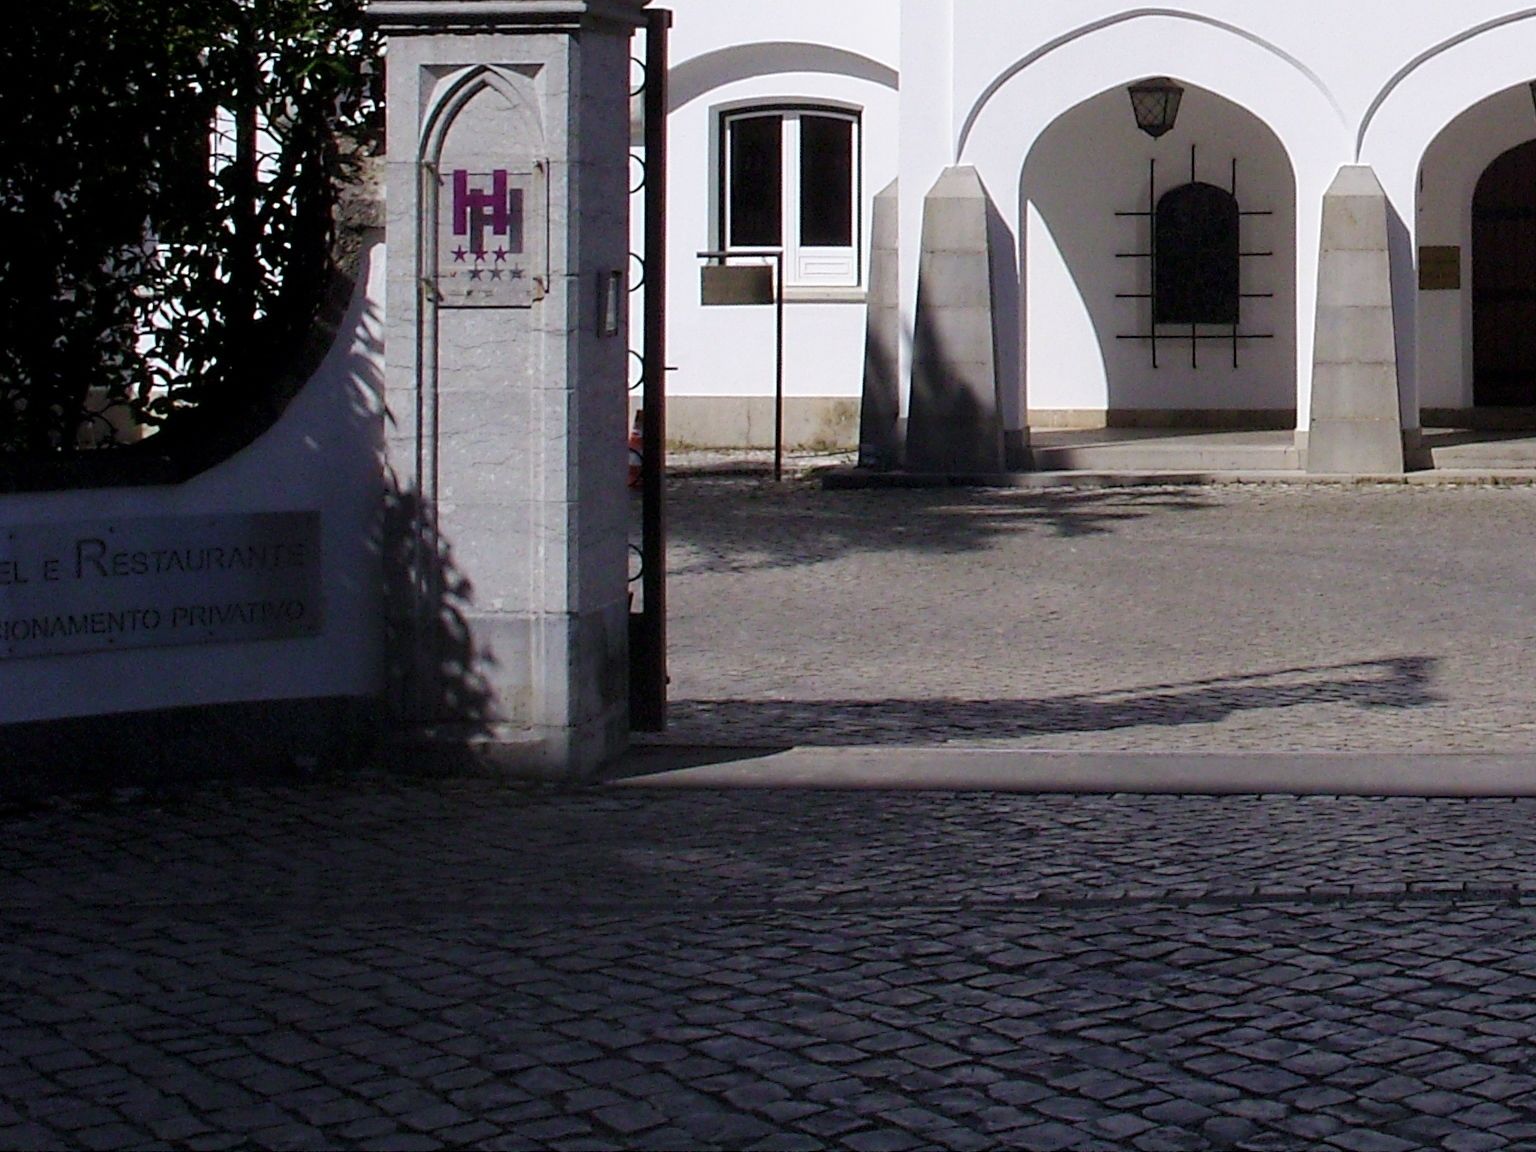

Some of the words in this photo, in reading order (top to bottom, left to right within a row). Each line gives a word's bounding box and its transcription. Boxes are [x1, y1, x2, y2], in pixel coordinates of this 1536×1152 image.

[41, 559, 59, 581] E
[76, 538, 305, 579] RESTAURANTE
[0, 608, 161, 641] IONAMENTO
[172, 600, 306, 629] PRIVATIVO
